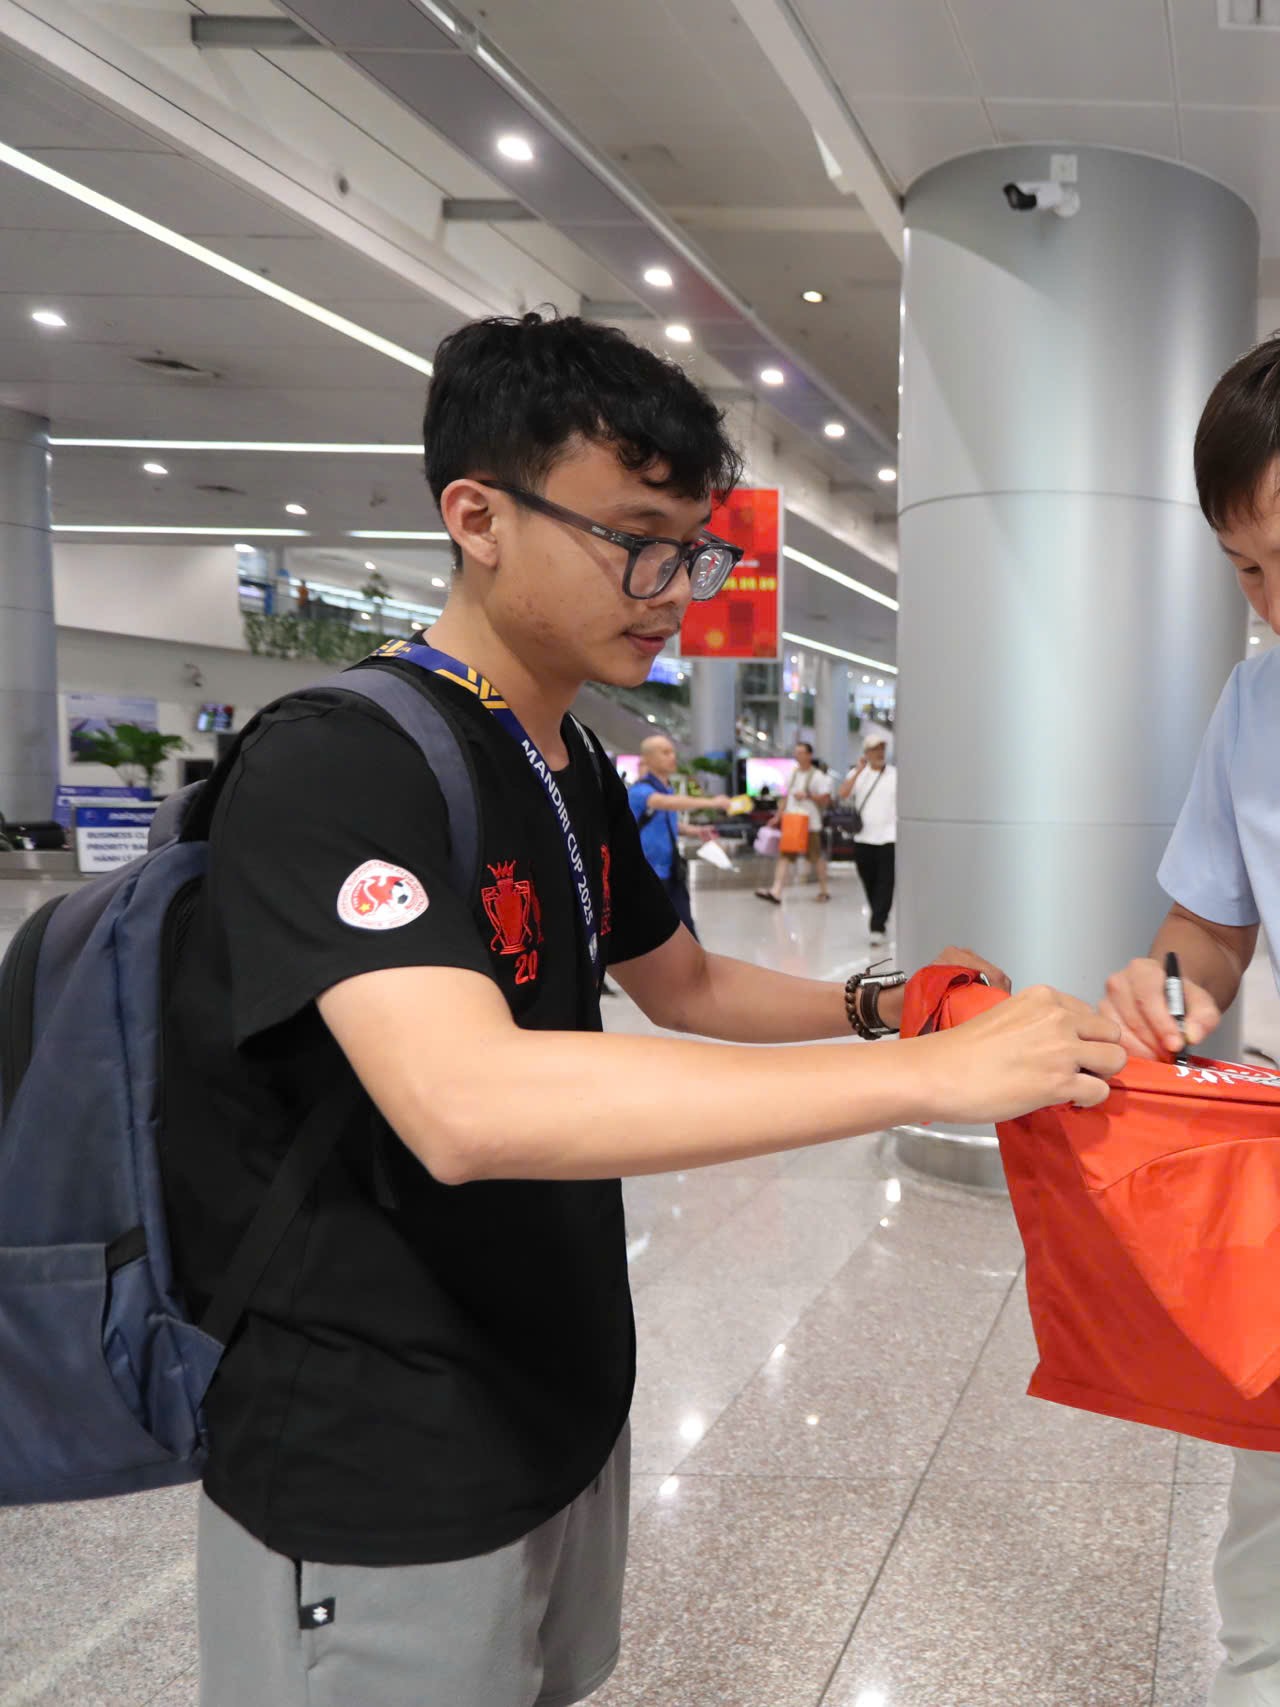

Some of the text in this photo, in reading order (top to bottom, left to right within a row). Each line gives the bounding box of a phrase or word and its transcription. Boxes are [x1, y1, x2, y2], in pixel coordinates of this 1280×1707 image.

[521, 739, 594, 926] MANDIRI CUP 2025
[515, 950, 537, 985] 20
